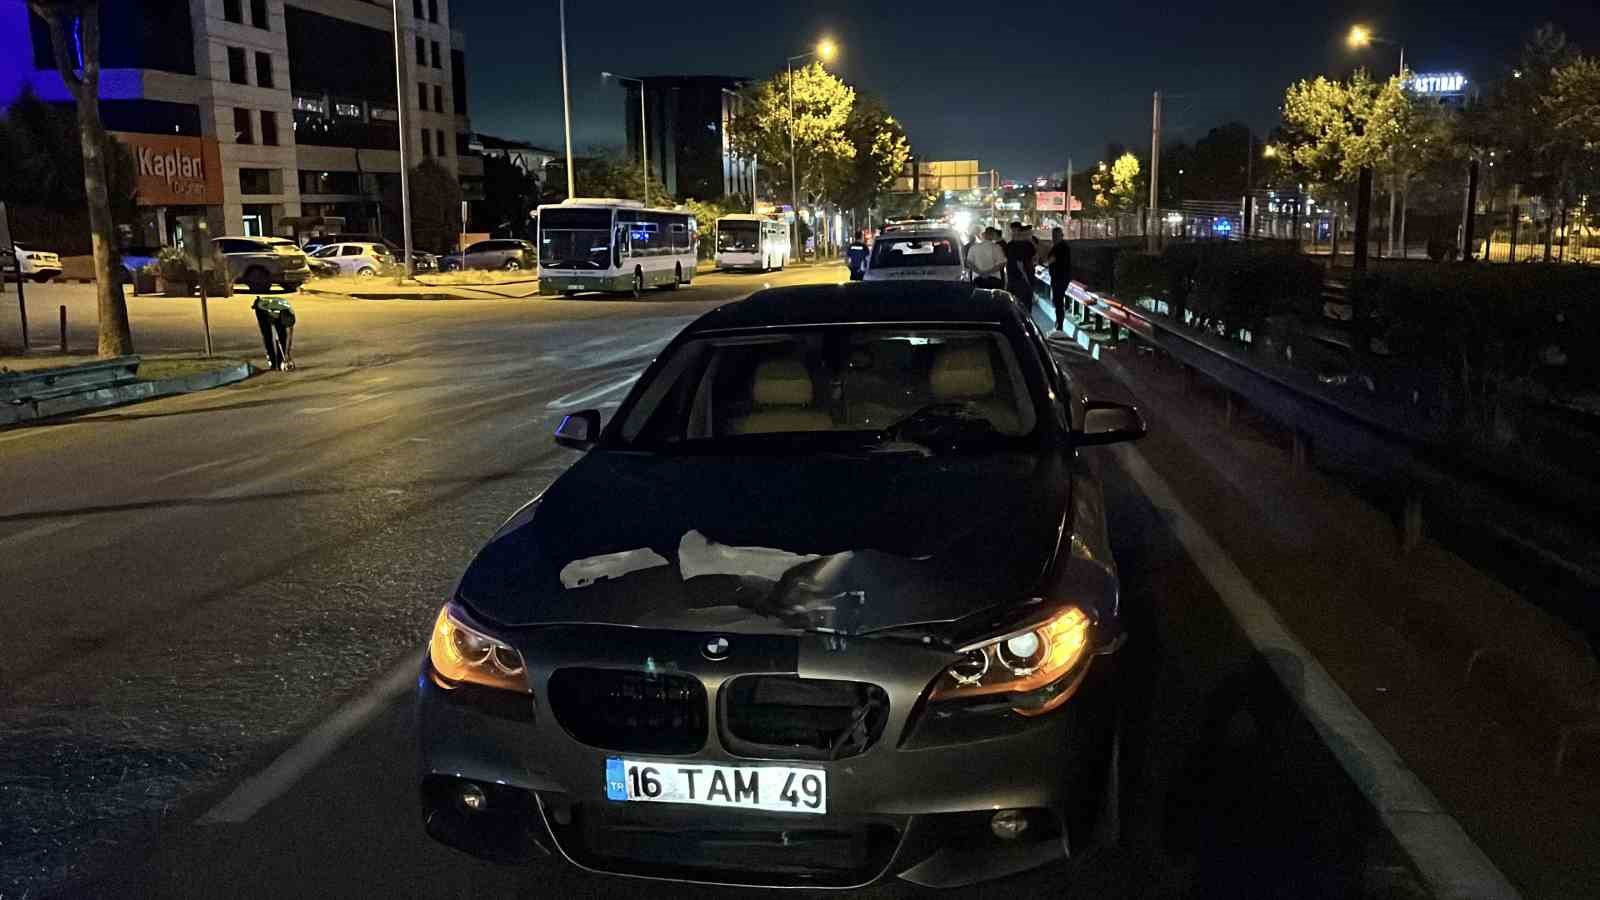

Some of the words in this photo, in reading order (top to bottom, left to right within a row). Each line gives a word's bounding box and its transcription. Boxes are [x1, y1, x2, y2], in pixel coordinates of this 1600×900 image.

[138, 147, 203, 185] Kaplan
[610, 781, 625, 792] TR
[628, 765, 662, 798] 16
[678, 768, 760, 804] TAM
[780, 772, 823, 809] 49
